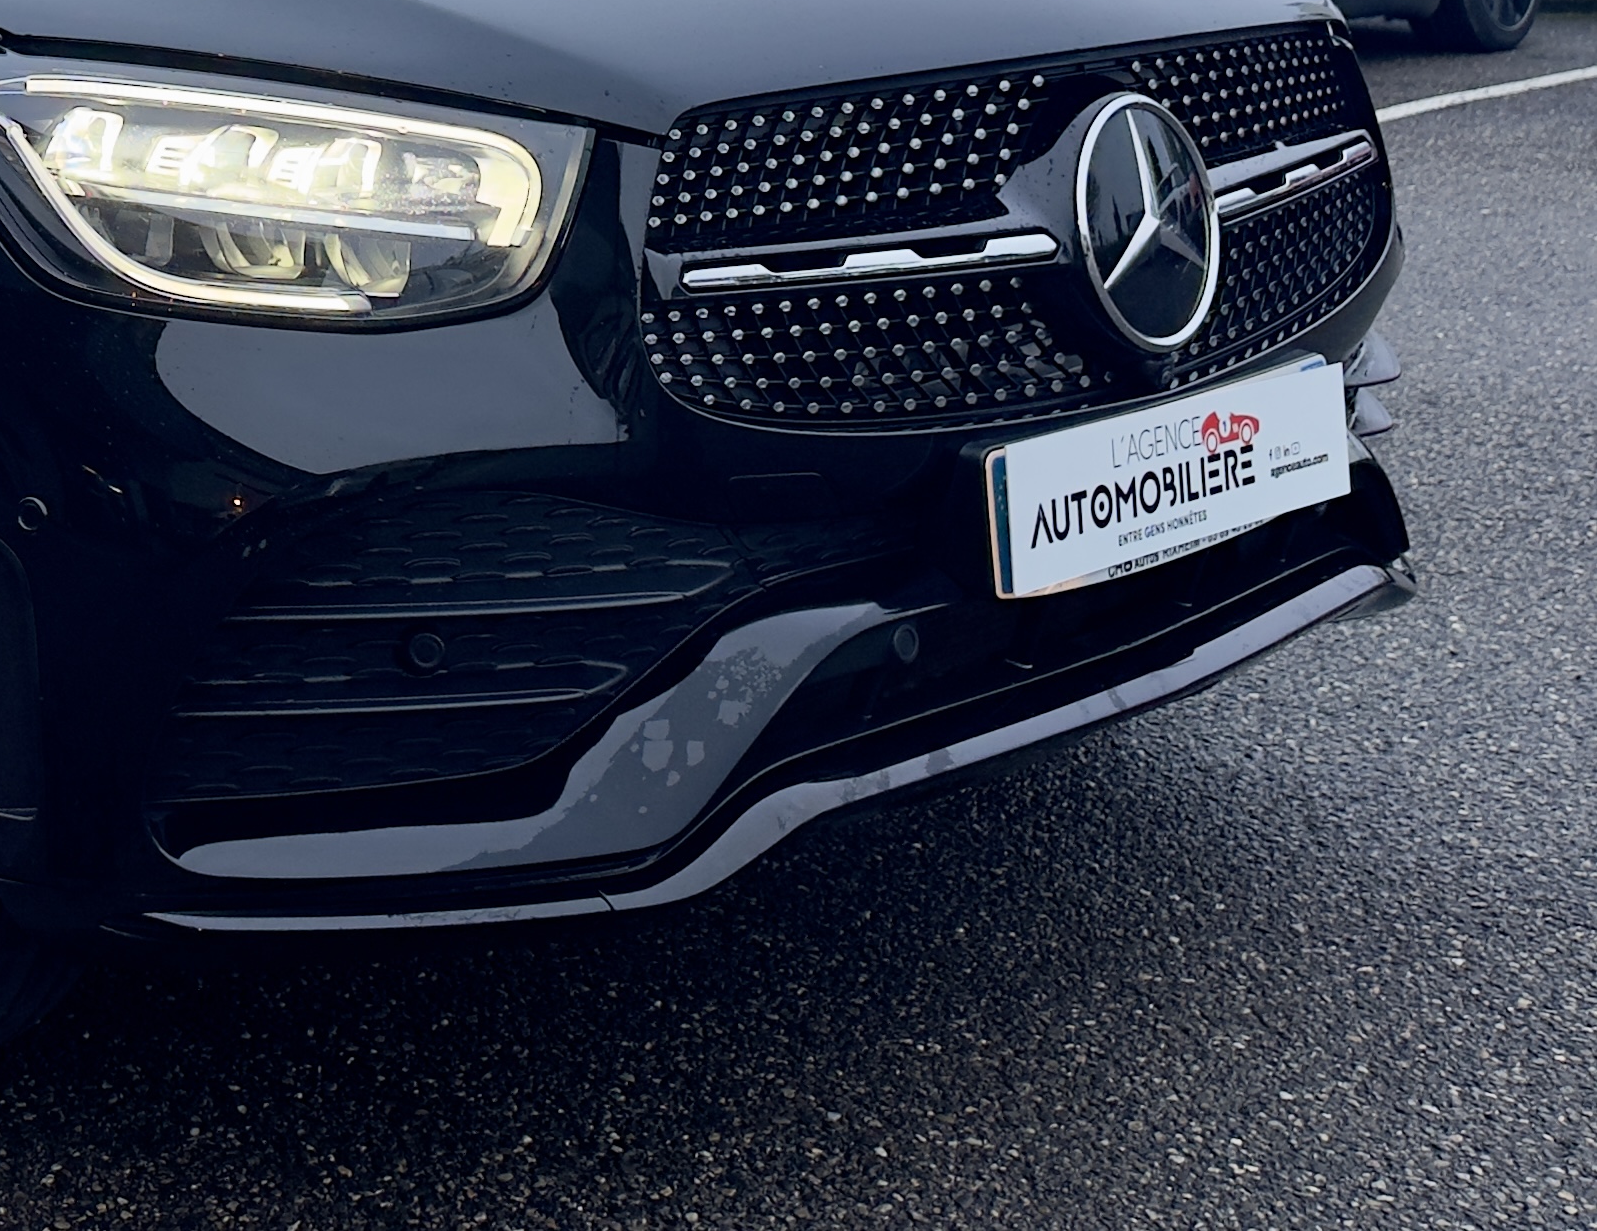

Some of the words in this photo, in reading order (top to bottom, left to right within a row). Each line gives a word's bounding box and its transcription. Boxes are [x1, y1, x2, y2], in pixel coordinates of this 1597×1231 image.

[1111, 416, 1202, 468] L'AGENCE
[1118, 528, 1143, 547] ENTRE
[1144, 522, 1166, 538] GENS
